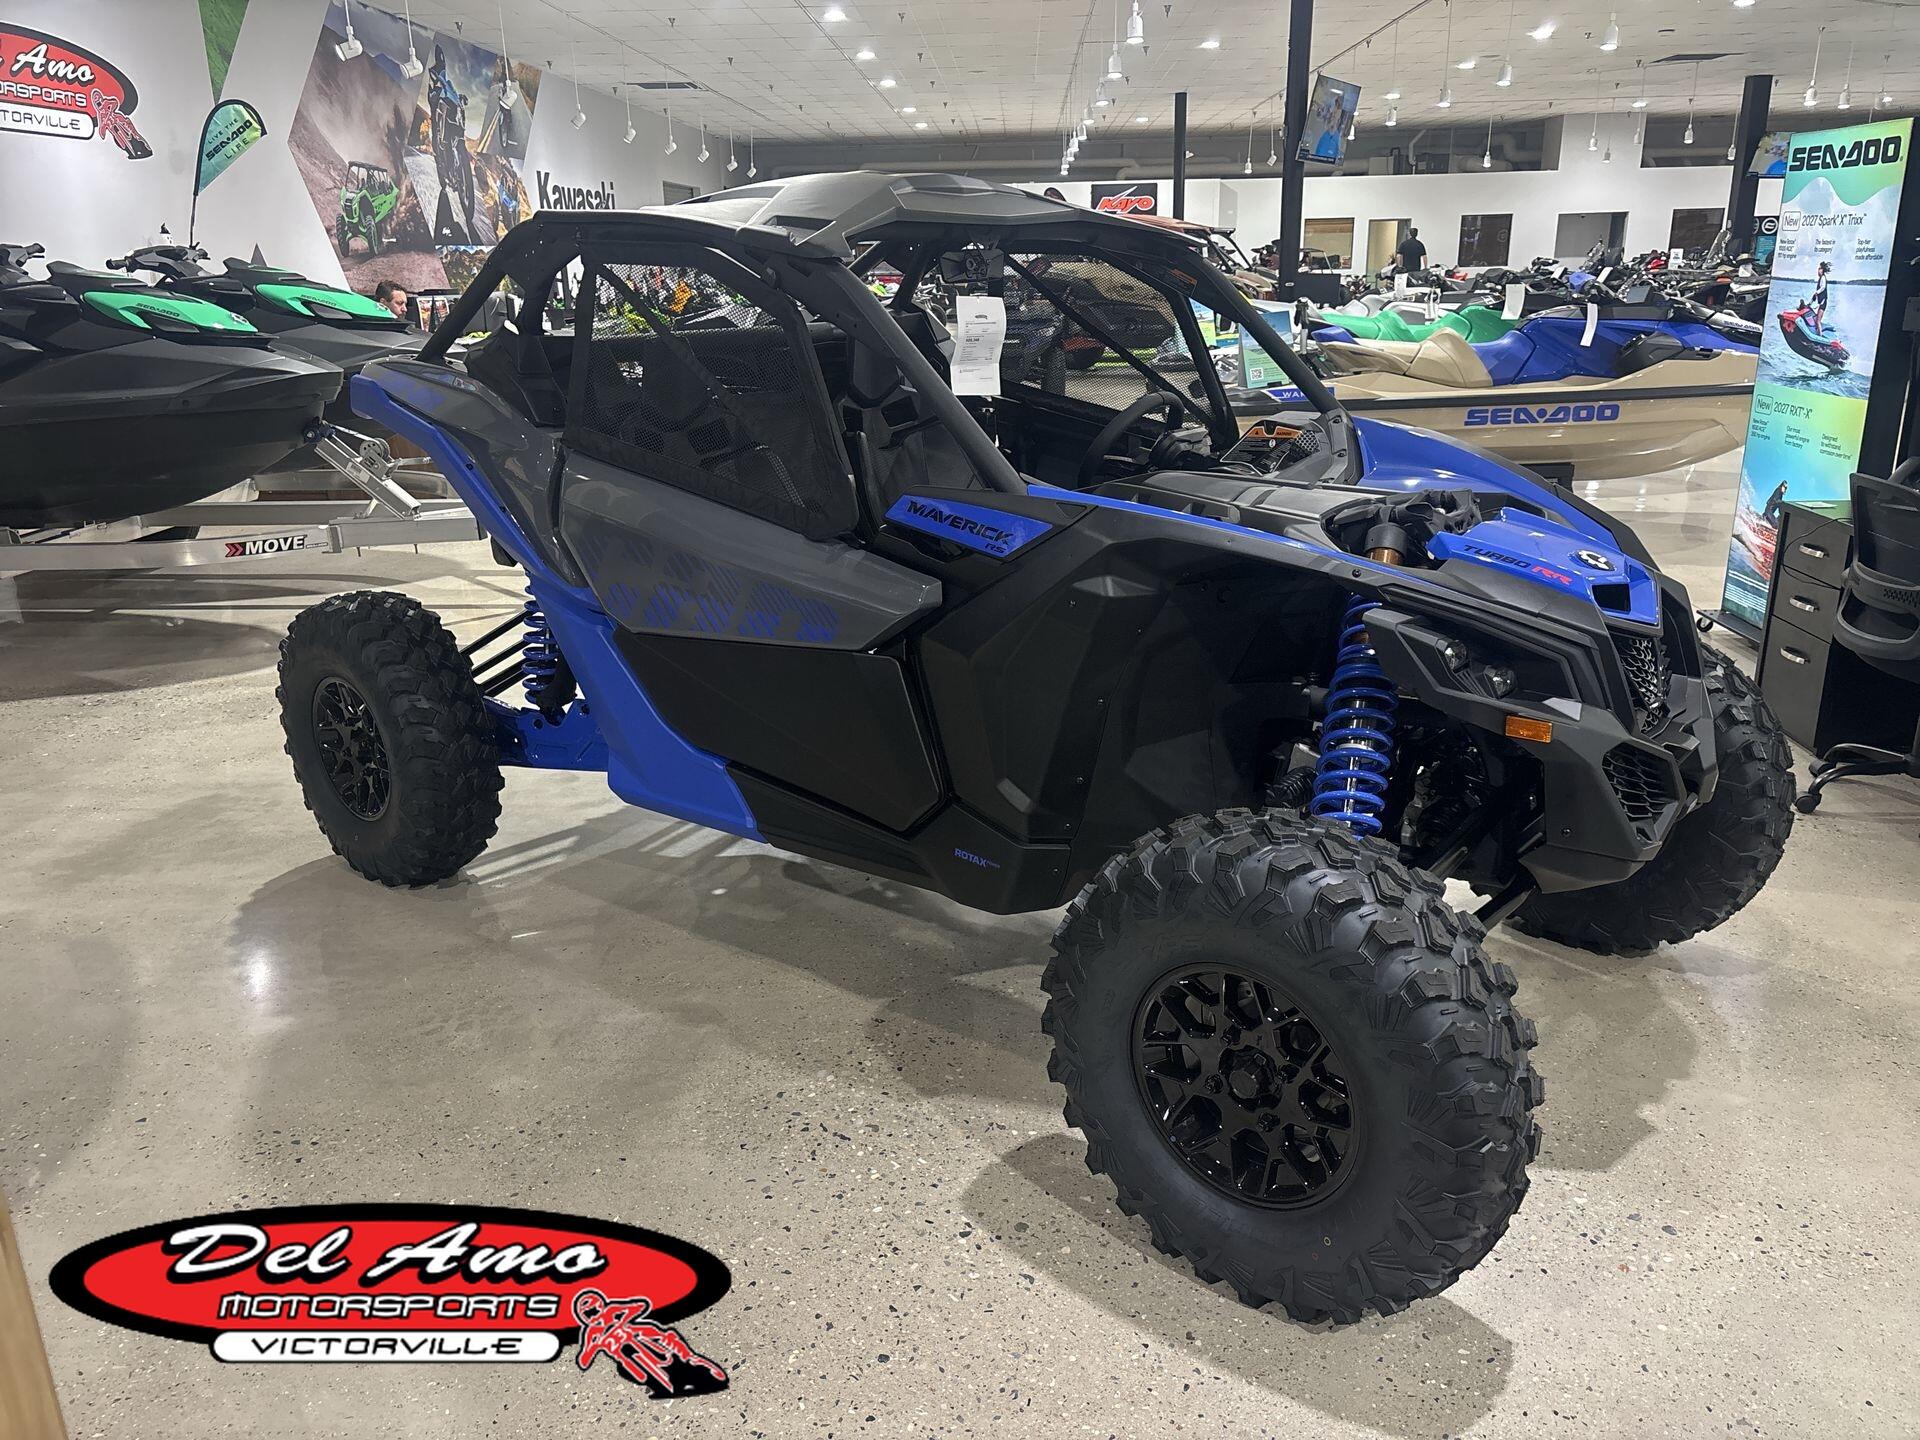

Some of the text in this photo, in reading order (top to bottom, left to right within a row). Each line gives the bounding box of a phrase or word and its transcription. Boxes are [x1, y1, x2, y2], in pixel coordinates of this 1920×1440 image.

[11, 43, 95, 82] Amo
[207, 118, 238, 144] LIVE THE
[225, 138, 249, 159] LIFE
[536, 170, 615, 210] Kawasaki
[1784, 216, 1798, 226] New
[1801, 215, 1818, 226] 2027
[1757, 399, 1770, 410] New
[1773, 401, 1790, 414] 2027
[906, 500, 1014, 546] MAVERICK
[245, 535, 304, 555] MOVE
[985, 543, 1006, 554] RS
[1463, 544, 1573, 586] TURBO RR
[954, 848, 987, 867] ROTAX
